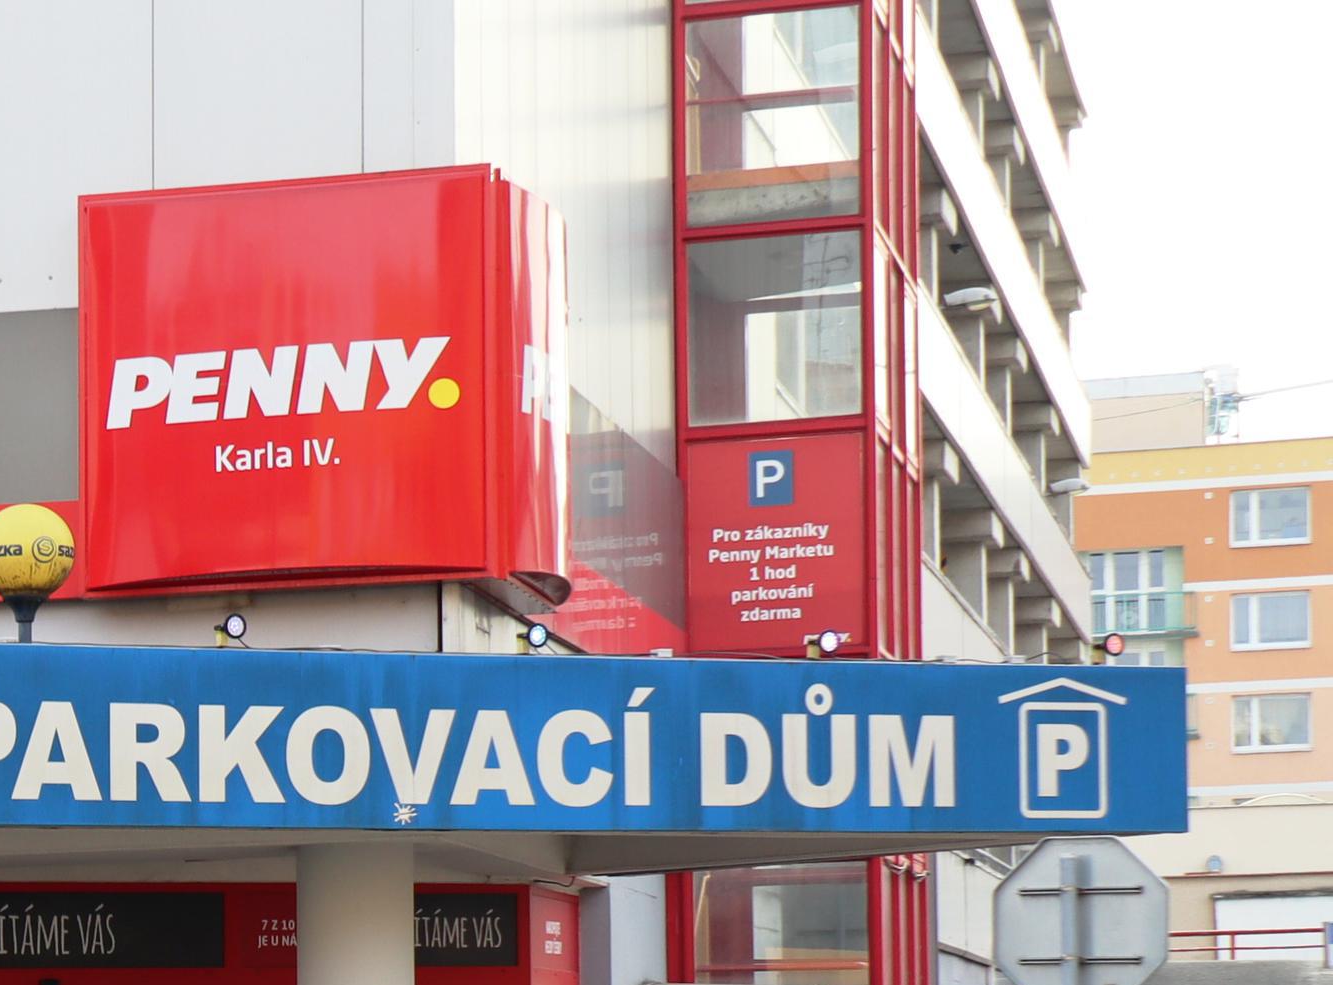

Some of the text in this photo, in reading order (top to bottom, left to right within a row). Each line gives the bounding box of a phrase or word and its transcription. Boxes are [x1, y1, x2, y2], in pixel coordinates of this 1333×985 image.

[215, 438, 341, 472] Karla IV.
[756, 460, 784, 497] P
[713, 523, 829, 542] Pro zákazníky
[709, 542, 834, 564] Penny Marketu
[750, 565, 796, 580] 1 hod
[731, 585, 814, 605] parkování
[740, 606, 801, 621] zdarma
[700, 683, 957, 810] DŮM
[75, 903, 116, 955] VÁS
[262, 919, 295, 931] 7 Z 10
[414, 908, 467, 948] ÍTÁME
[473, 908, 501, 948] VÁS
[258, 936, 269, 948] JE
[271, 935, 279, 947] U
